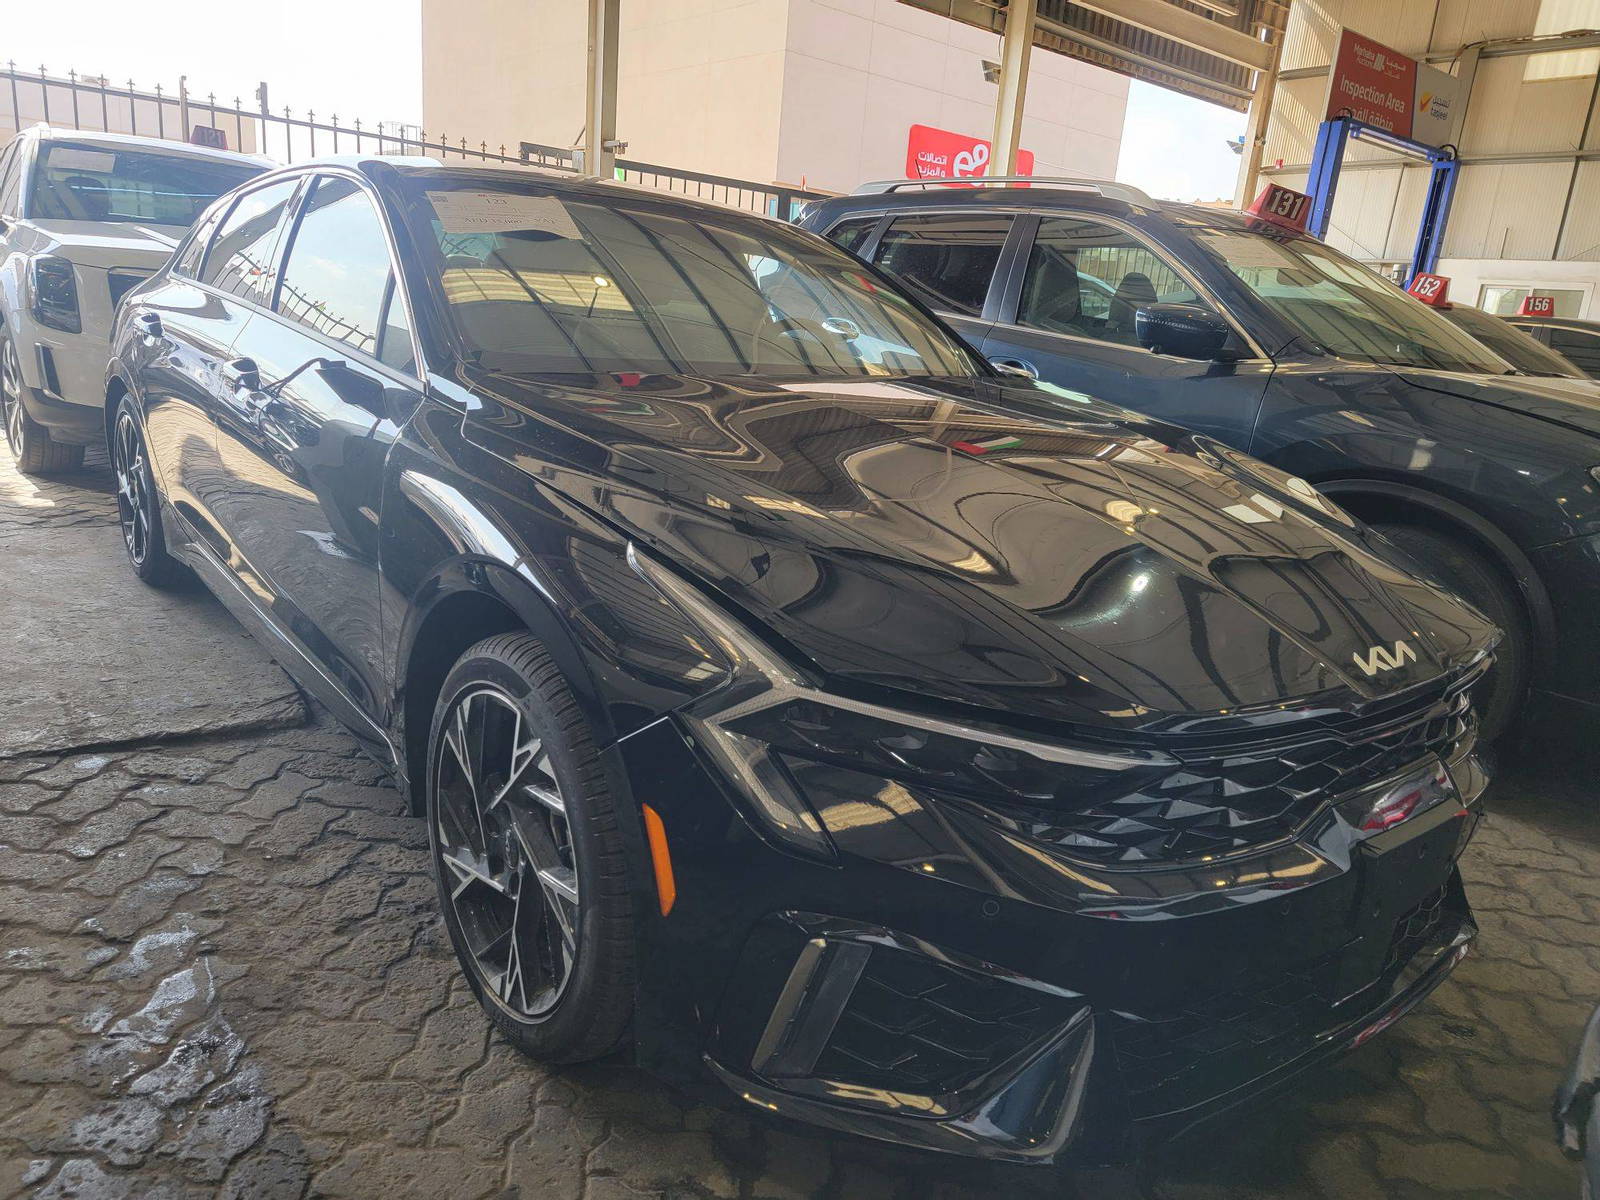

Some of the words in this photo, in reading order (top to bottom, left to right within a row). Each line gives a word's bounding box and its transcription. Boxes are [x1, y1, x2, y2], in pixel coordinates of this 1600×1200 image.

[1340, 74, 1385, 105] Inspection
[1385, 93, 1406, 113] Area
[1270, 190, 1304, 219] 131
[1414, 276, 1441, 297] 152
[1528, 298, 1550, 312] 156
